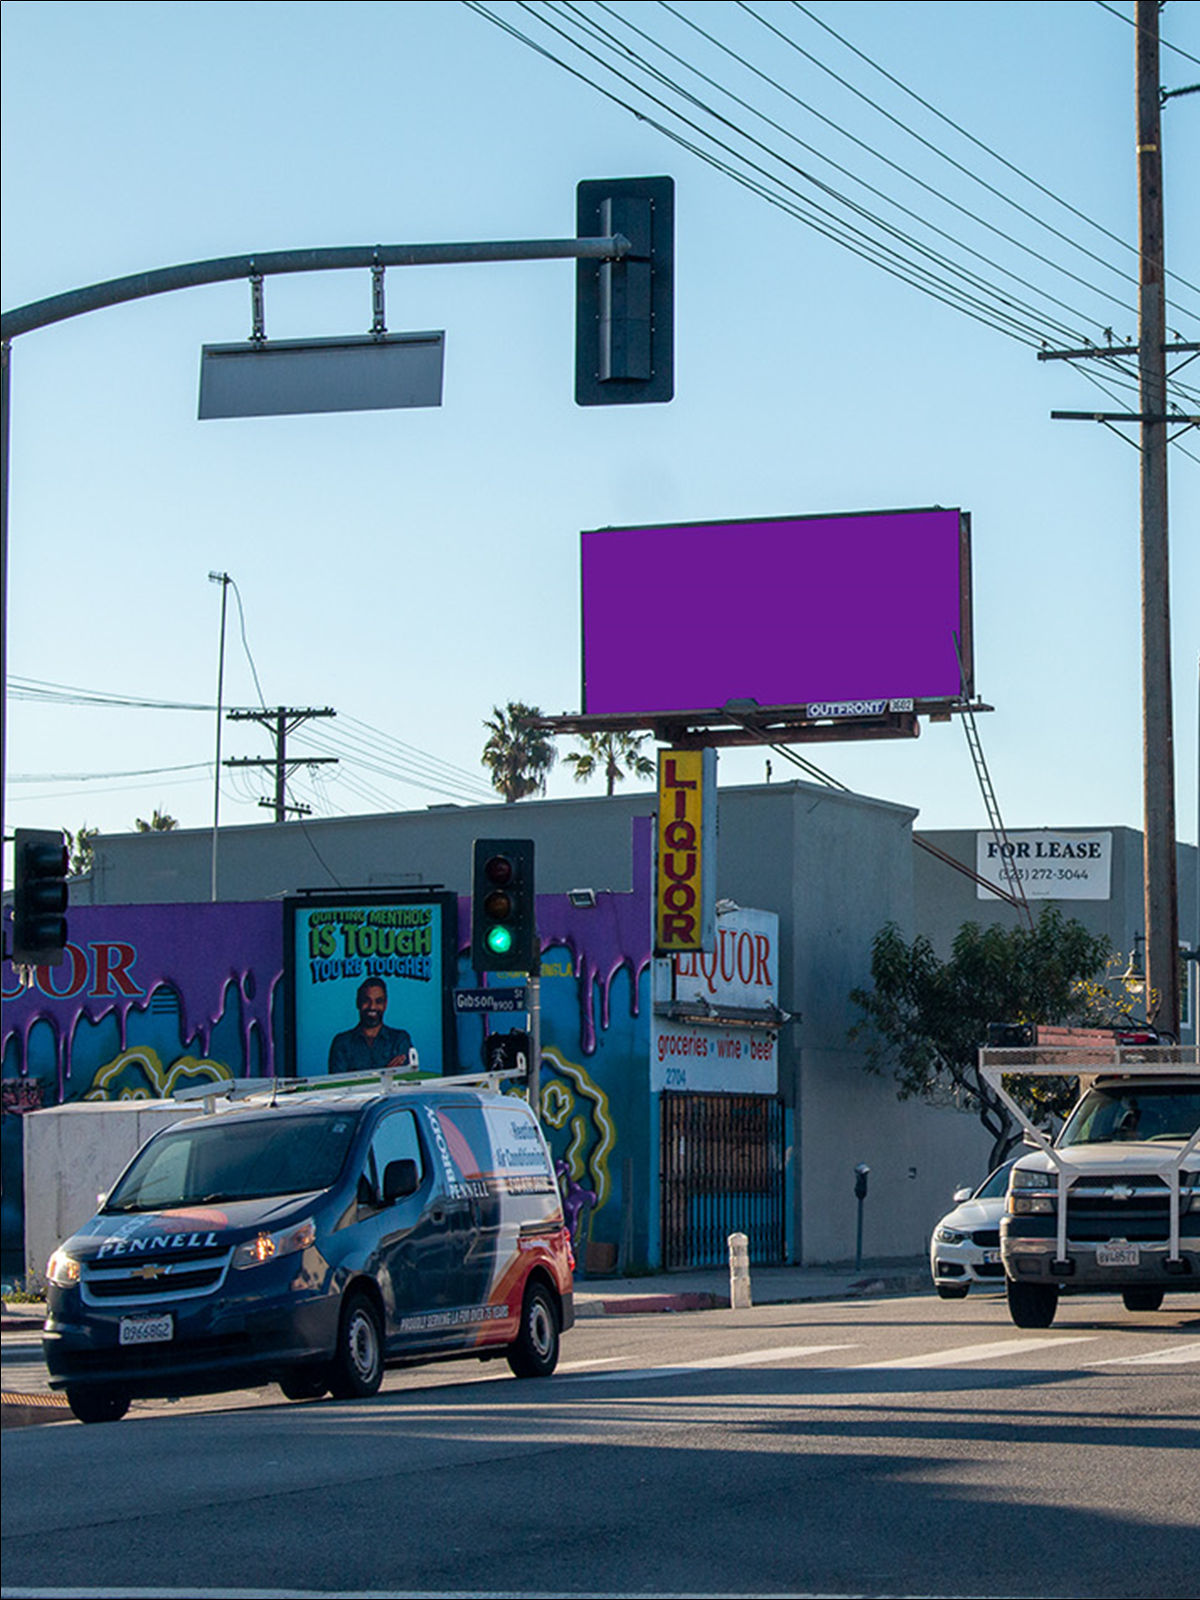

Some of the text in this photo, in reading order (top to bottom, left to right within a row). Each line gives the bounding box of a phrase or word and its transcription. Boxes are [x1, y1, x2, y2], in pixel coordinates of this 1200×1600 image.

[810, 701, 880, 716] OUTFRONT
[663, 759, 697, 944] LIQUOR
[987, 842, 1101, 858] FOR LEASE
[999, 868, 1088, 881] (323) 272-3044
[310, 909, 432, 926] QUITTING MENTHOLS
[309, 924, 432, 958] IS TOUGH
[366, 957, 432, 981] TOUGHER
[457, 994, 494, 1008] Gibson
[657, 1031, 774, 1062] groceries wine beer
[666, 1069, 686, 1085] 2704
[449, 1181, 489, 1199] PENNELL
[97, 1233, 218, 1259] PENNELL
[427, 1313, 451, 1327] SERVING
